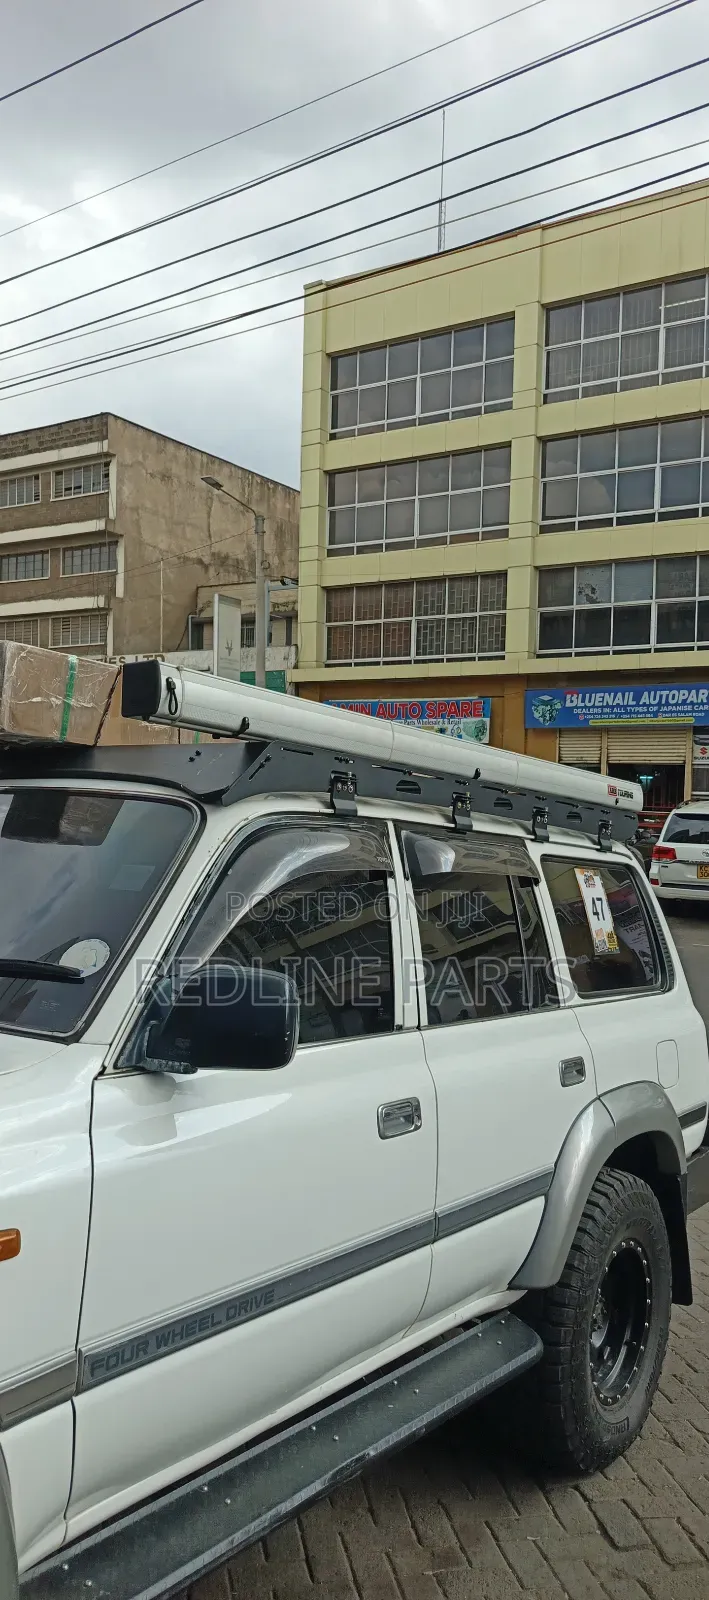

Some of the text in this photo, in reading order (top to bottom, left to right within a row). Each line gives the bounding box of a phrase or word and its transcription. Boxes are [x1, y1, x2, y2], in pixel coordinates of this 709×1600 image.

[564, 688, 708, 708] BLUENAIL AUTOPAR
[375, 701, 422, 719] AUTO
[425, 700, 484, 719] SPARE
[591, 896, 606, 921] 47
[90, 1289, 275, 1377] FOUR WHEEL DRIVE
